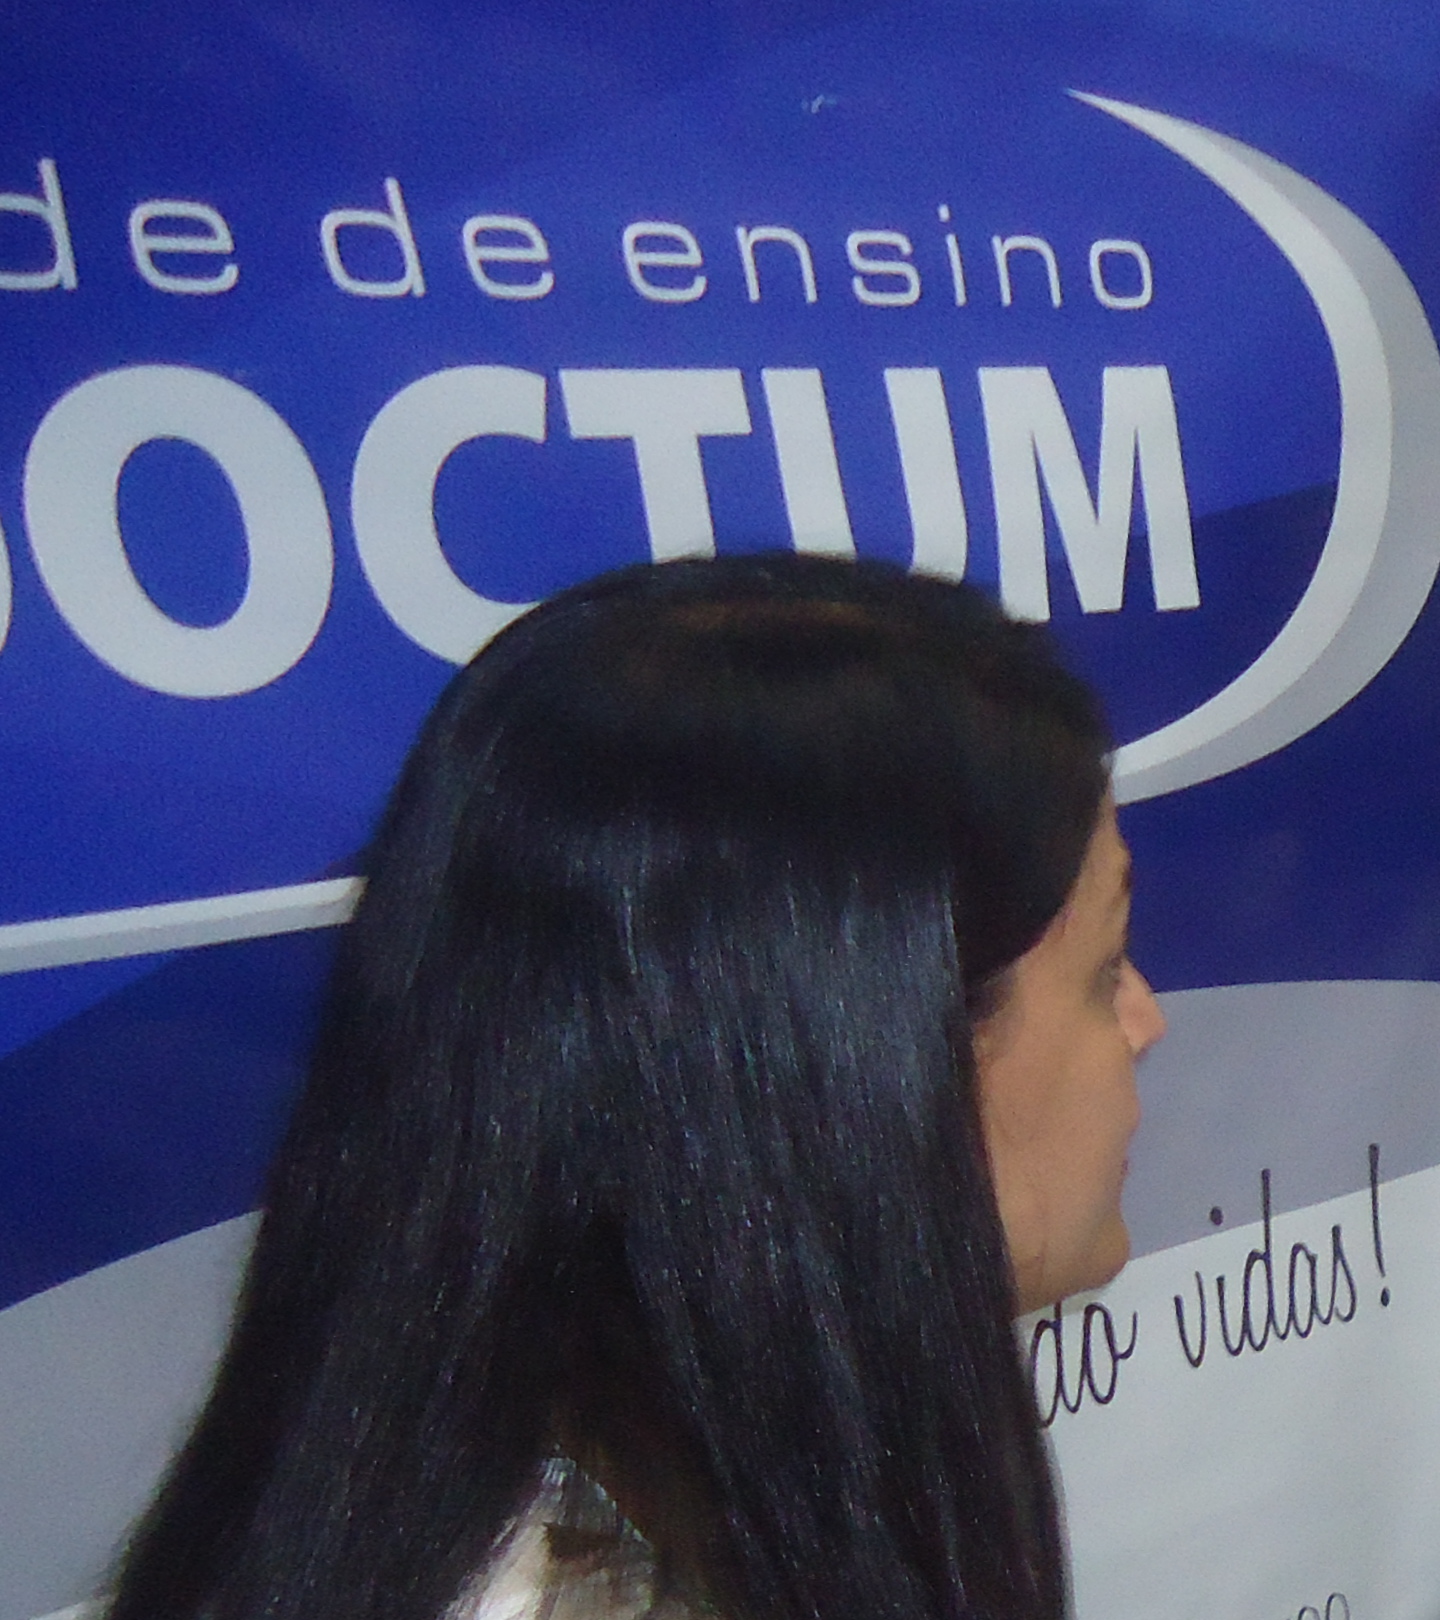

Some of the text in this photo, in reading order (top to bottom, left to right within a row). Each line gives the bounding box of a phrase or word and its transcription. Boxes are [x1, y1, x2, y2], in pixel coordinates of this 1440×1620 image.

[319, 178, 555, 301] de
[622, 206, 1154, 310] ensino
[0, 364, 1202, 698] OCTUM
[1174, 1143, 1390, 1369] vidas!
